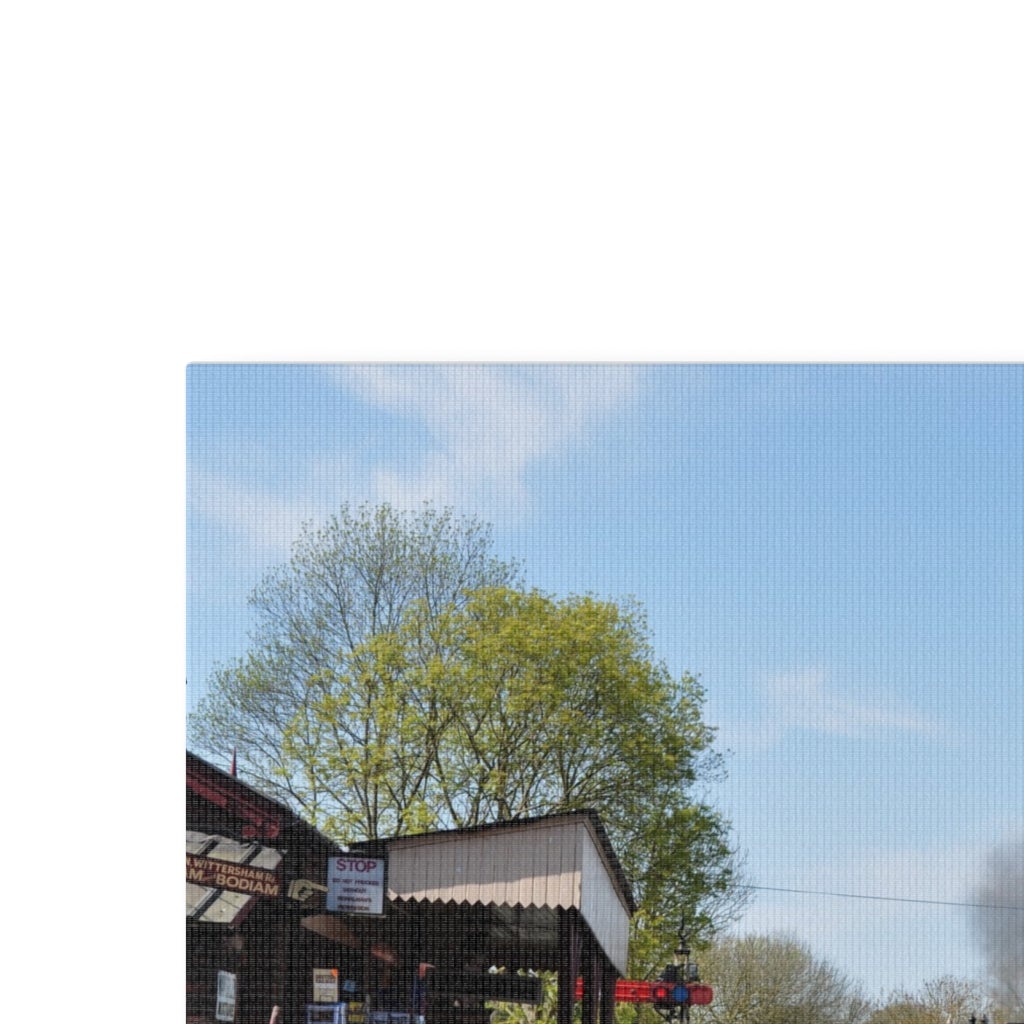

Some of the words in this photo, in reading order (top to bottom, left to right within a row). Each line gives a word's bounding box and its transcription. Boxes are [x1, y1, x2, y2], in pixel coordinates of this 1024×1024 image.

[194, 858, 264, 881] WITTERSHAM
[336, 858, 377, 873] STOP
[216, 873, 279, 896] BODIAM
